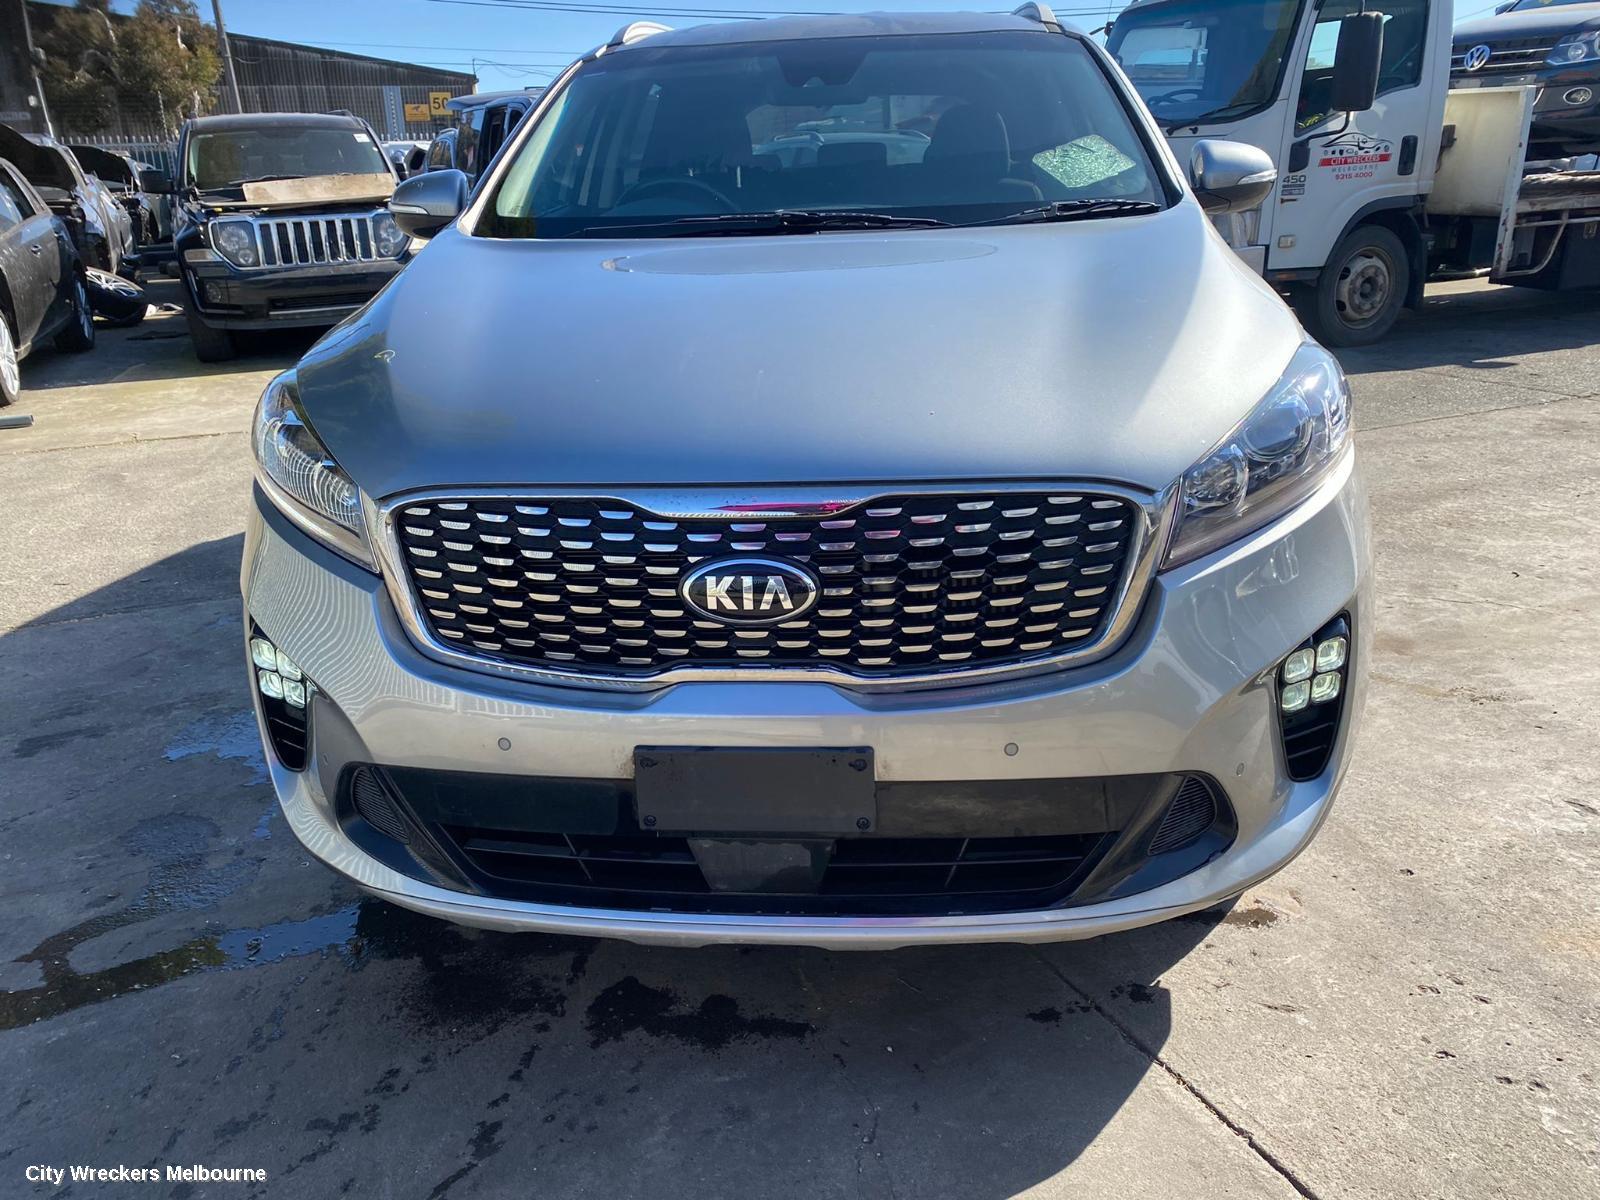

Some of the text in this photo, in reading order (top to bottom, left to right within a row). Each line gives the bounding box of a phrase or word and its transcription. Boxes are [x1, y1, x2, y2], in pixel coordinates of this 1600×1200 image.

[1331, 155, 1380, 165] CITY WRECKERS
[1332, 164, 1379, 172] MELBOURNE
[1282, 175, 1306, 183] 450
[705, 575, 794, 610] KIA
